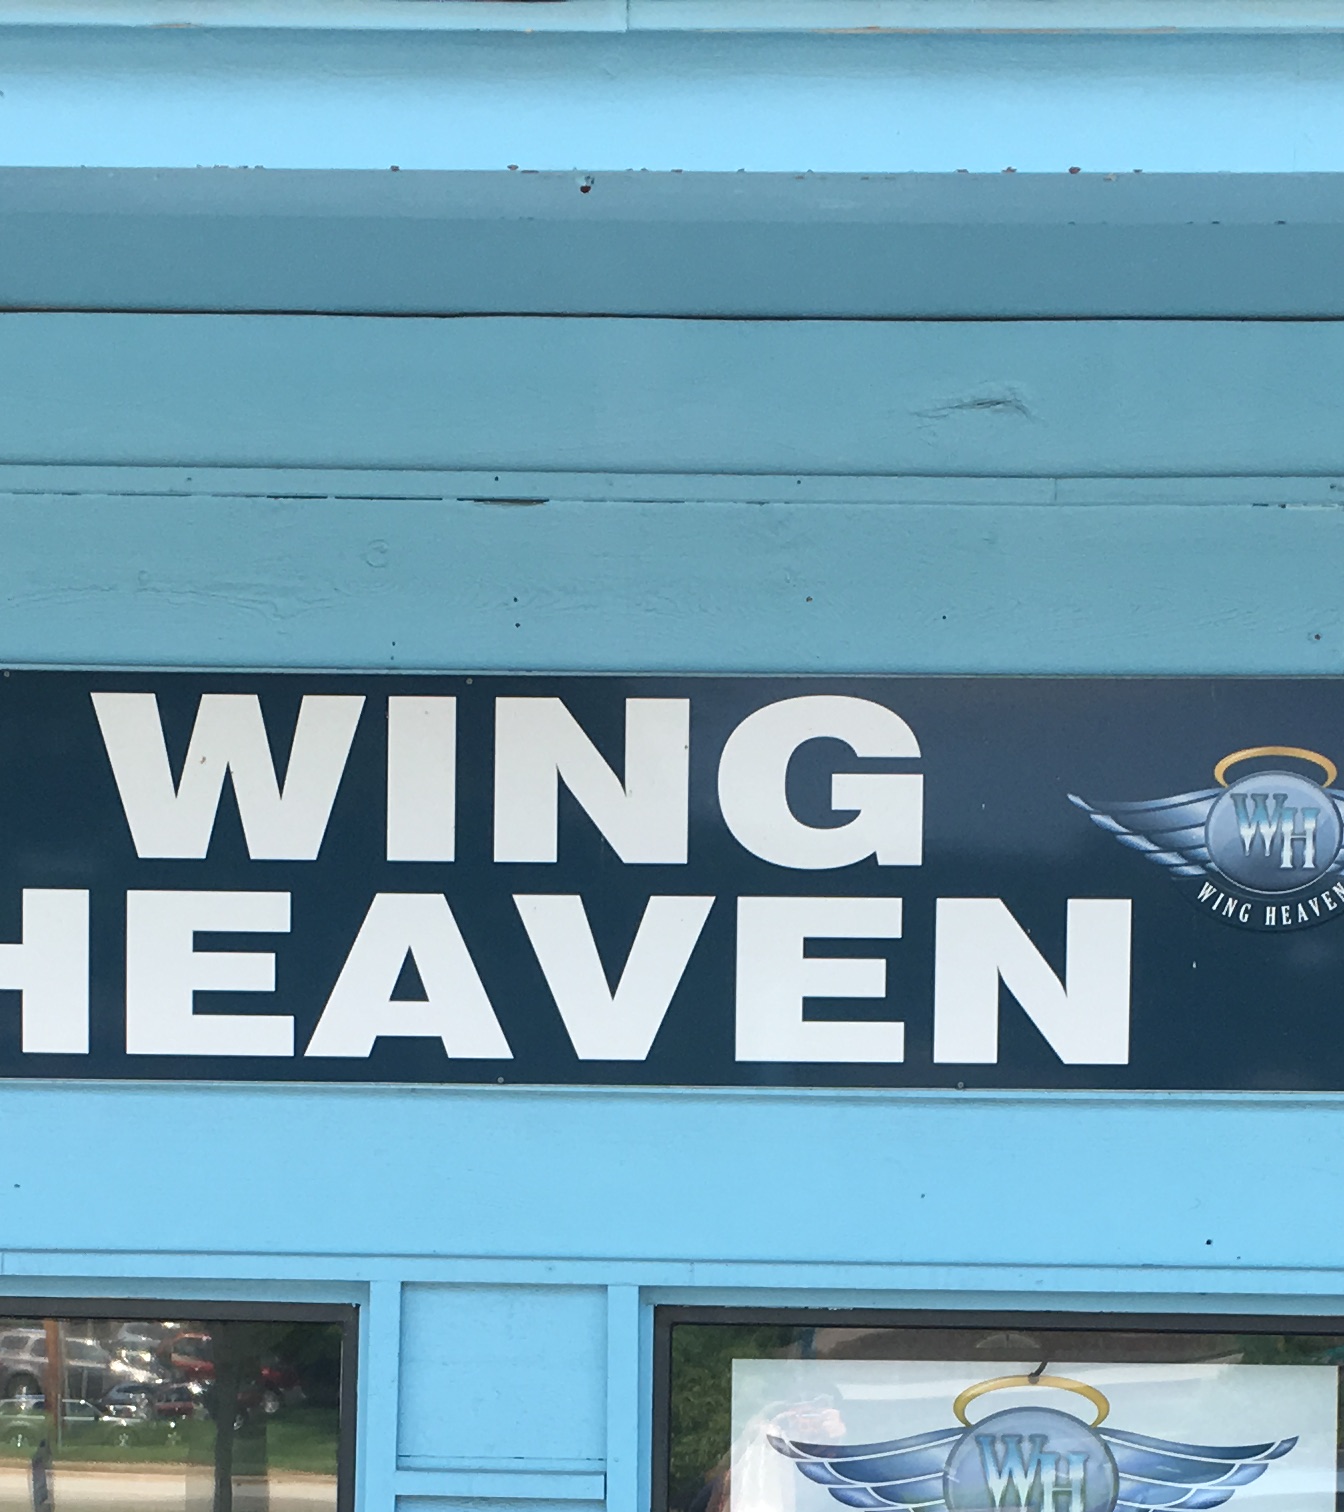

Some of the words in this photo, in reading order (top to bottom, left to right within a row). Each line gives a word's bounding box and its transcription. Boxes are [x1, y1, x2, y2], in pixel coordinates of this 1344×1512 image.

[89, 691, 925, 871] WING
[1229, 792, 1322, 869] WH
[1197, 881, 1252, 923] WING
